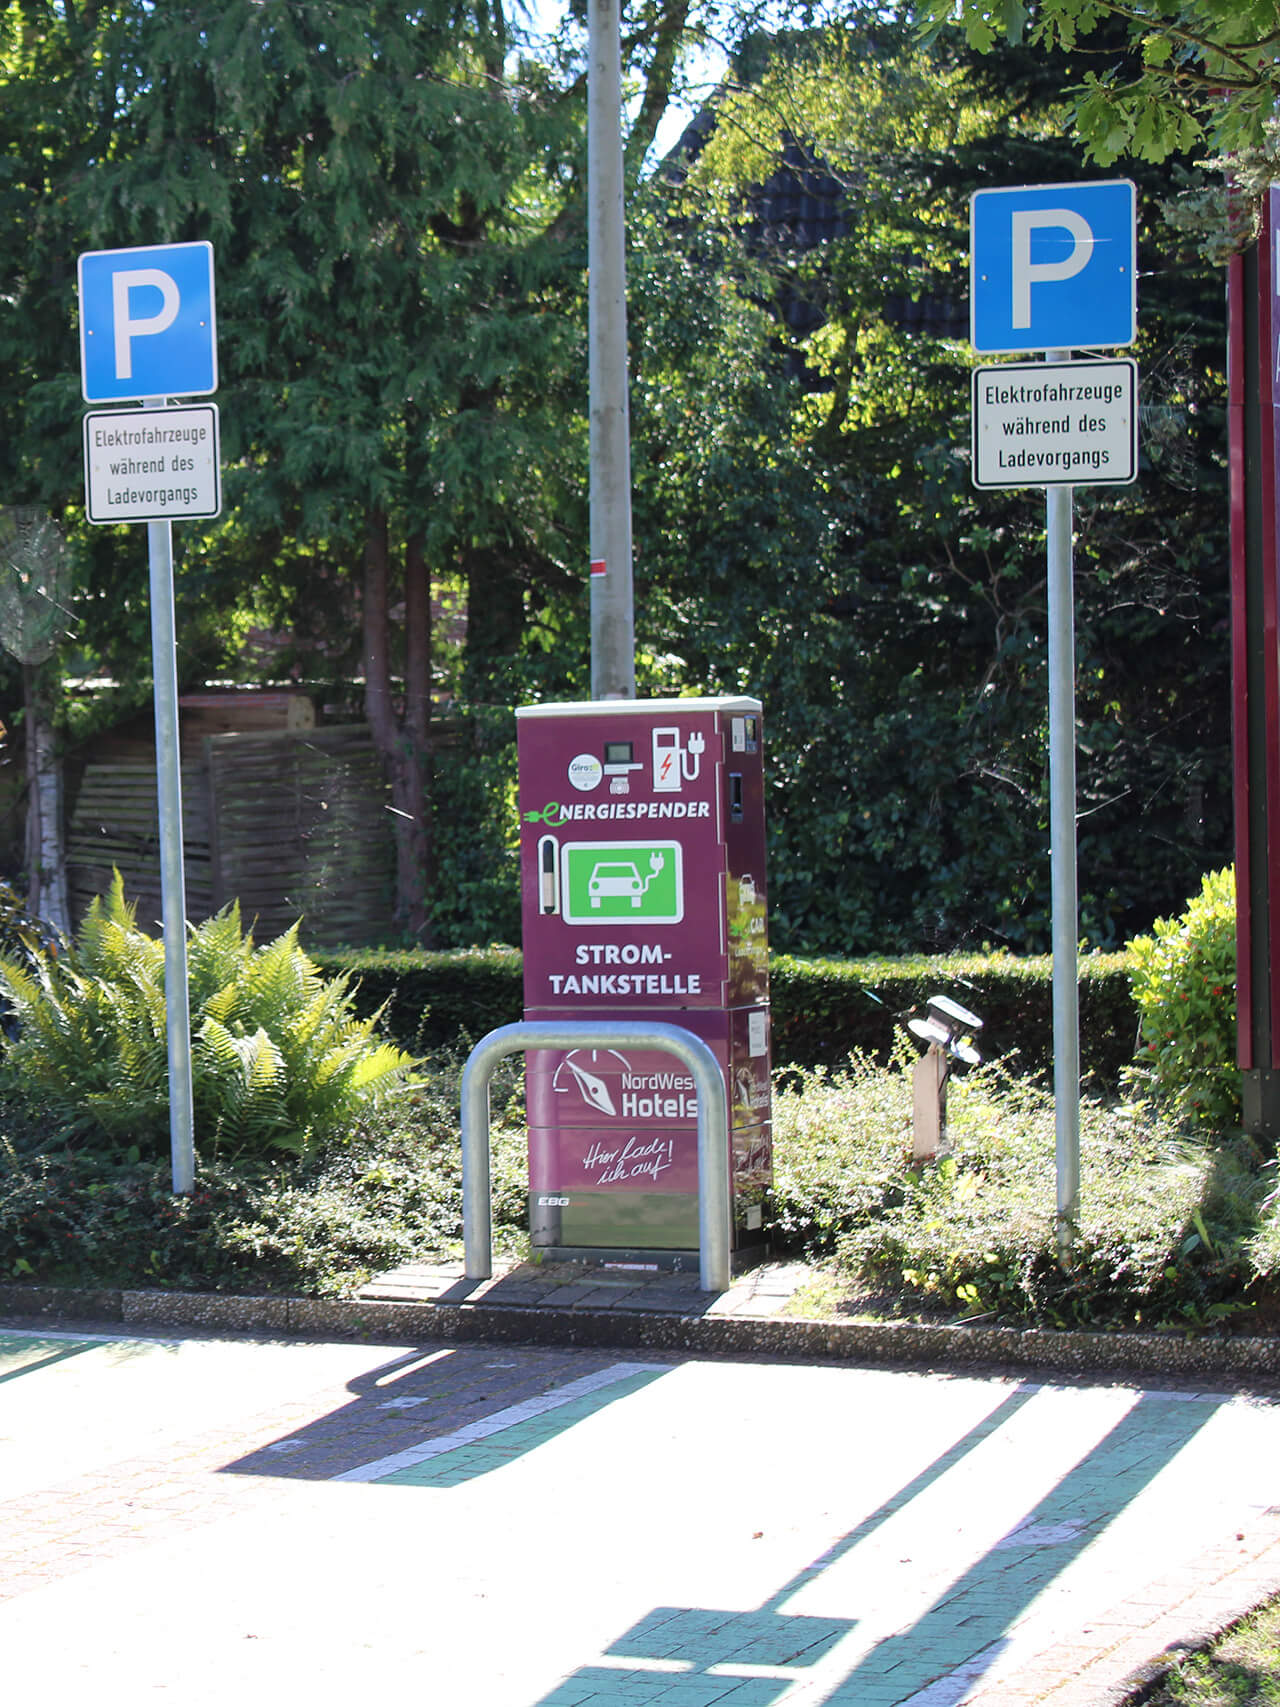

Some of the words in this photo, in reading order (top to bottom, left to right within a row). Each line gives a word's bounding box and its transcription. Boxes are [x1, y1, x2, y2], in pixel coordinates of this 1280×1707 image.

[1012, 208, 1094, 329] P
[112, 268, 181, 380] P
[985, 384, 1123, 405] Elektrofahrzeuge
[1002, 416, 1071, 435] während
[1079, 414, 1107, 432] des
[95, 427, 207, 448] Elektrofahrzeuge
[109, 457, 165, 475] während
[171, 456, 195, 472] des
[998, 448, 1110, 470] Ladevorgangs
[107, 486, 199, 506] Ladevorgangs
[575, 944, 672, 965] STROM-
[548, 974, 702, 995] TANKSTELLE
[622, 1093, 698, 1118] Hotels
[596, 1160, 630, 1185] ich
[631, 1153, 672, 1181] auf
[537, 1196, 570, 1207] EBG
